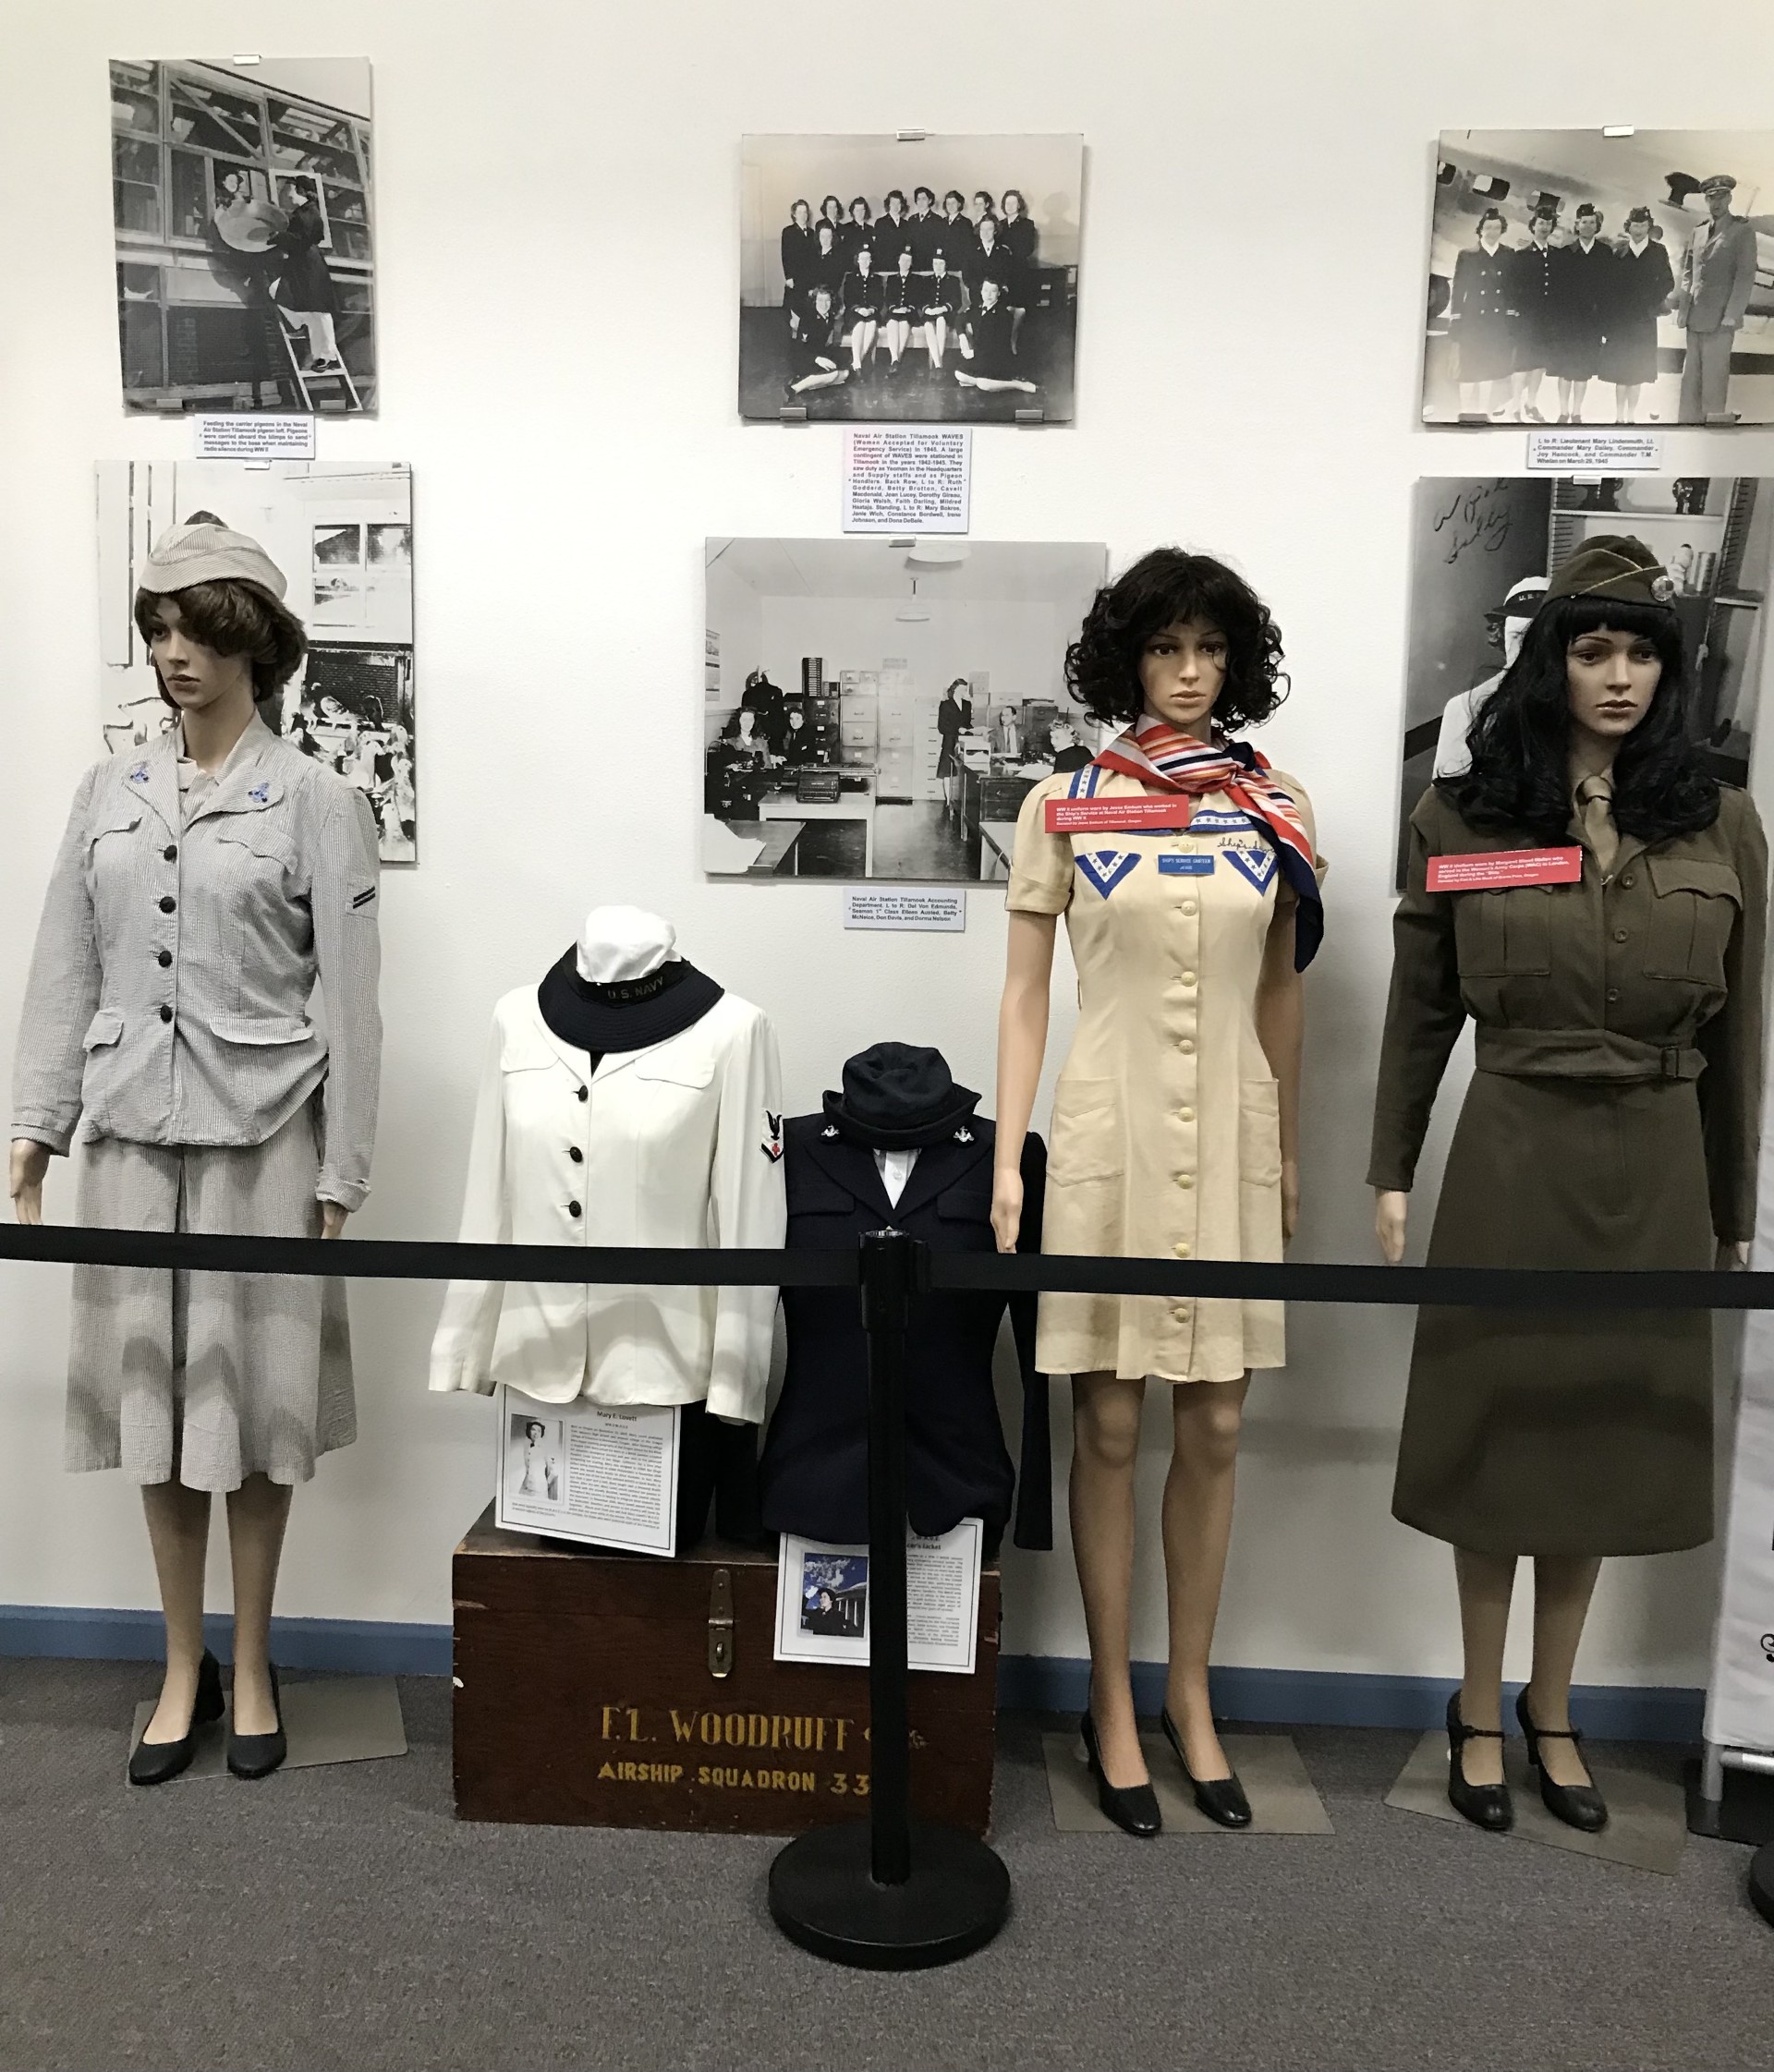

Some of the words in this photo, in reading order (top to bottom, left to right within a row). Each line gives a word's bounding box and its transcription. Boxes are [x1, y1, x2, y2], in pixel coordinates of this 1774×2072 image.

[635, 976, 663, 996] NAVY
[669, 1709, 856, 1752] WOODRUFF
[597, 1761, 684, 1784] AIRSHIP
[698, 1766, 817, 1793] SQUADRON
